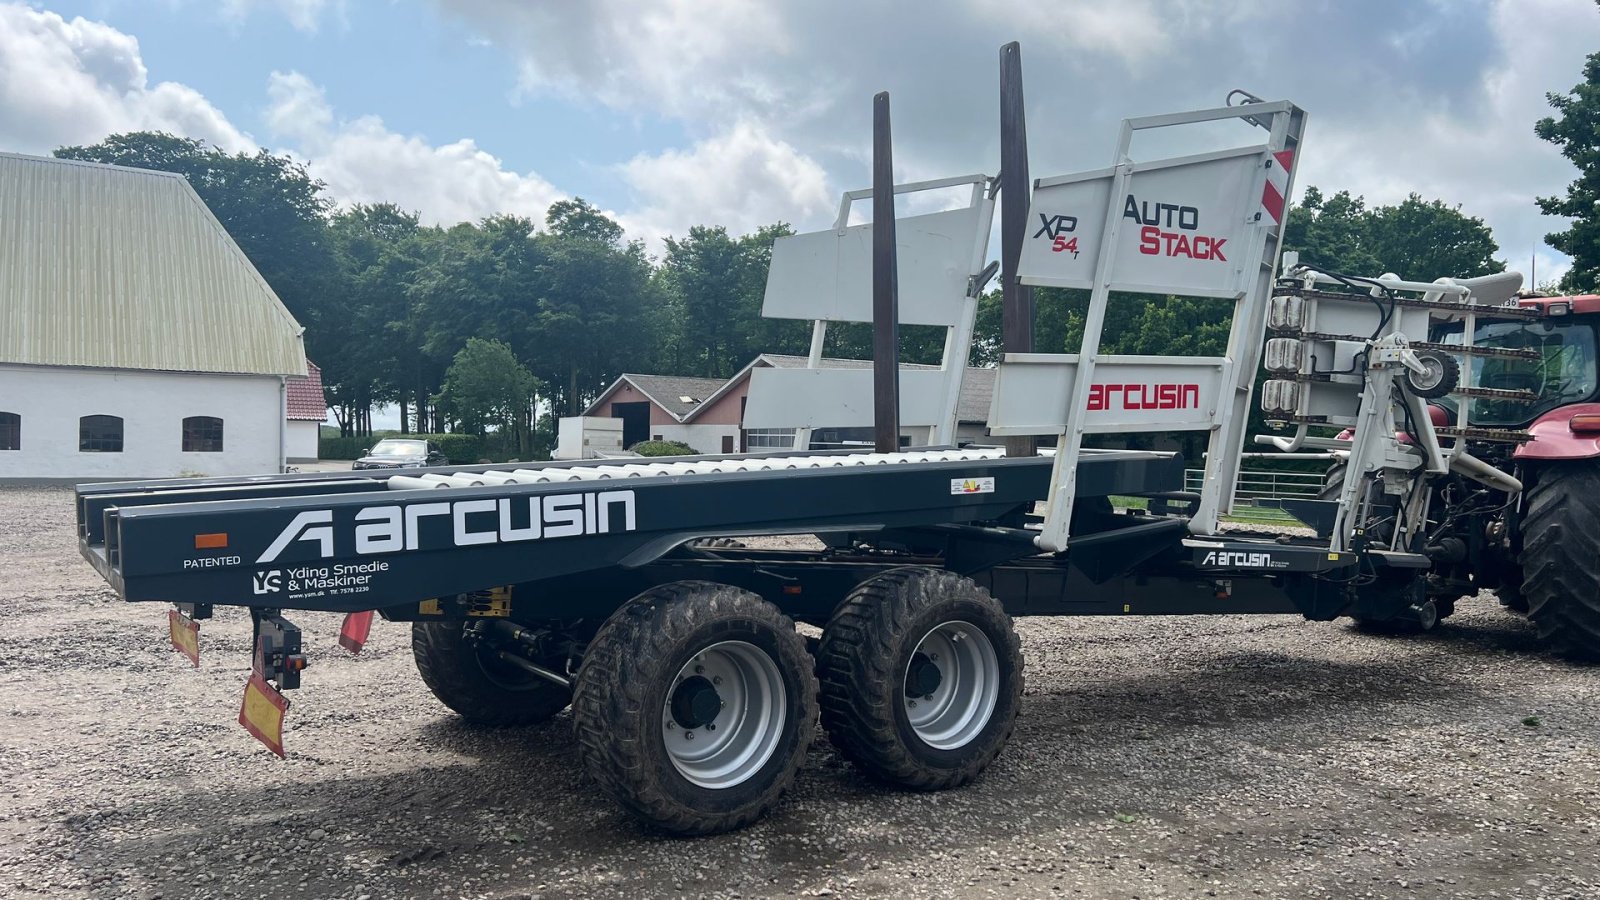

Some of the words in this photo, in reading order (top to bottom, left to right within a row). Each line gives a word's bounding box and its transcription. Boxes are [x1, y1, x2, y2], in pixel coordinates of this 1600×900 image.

[1123, 194, 1199, 231] AUTO
[1033, 213, 1078, 241] XP
[1139, 226, 1228, 262] STACK
[1086, 384, 1199, 410] arcusin
[355, 489, 637, 555] arcusin
[183, 555, 241, 569] PATENTED
[286, 566, 329, 580] Yding
[333, 560, 389, 576] Smedie
[1218, 551, 1271, 568] arcusin
[288, 579, 301, 591] &
[304, 573, 372, 590] Maskiner
[289, 590, 325, 600] www.ysm.dk
